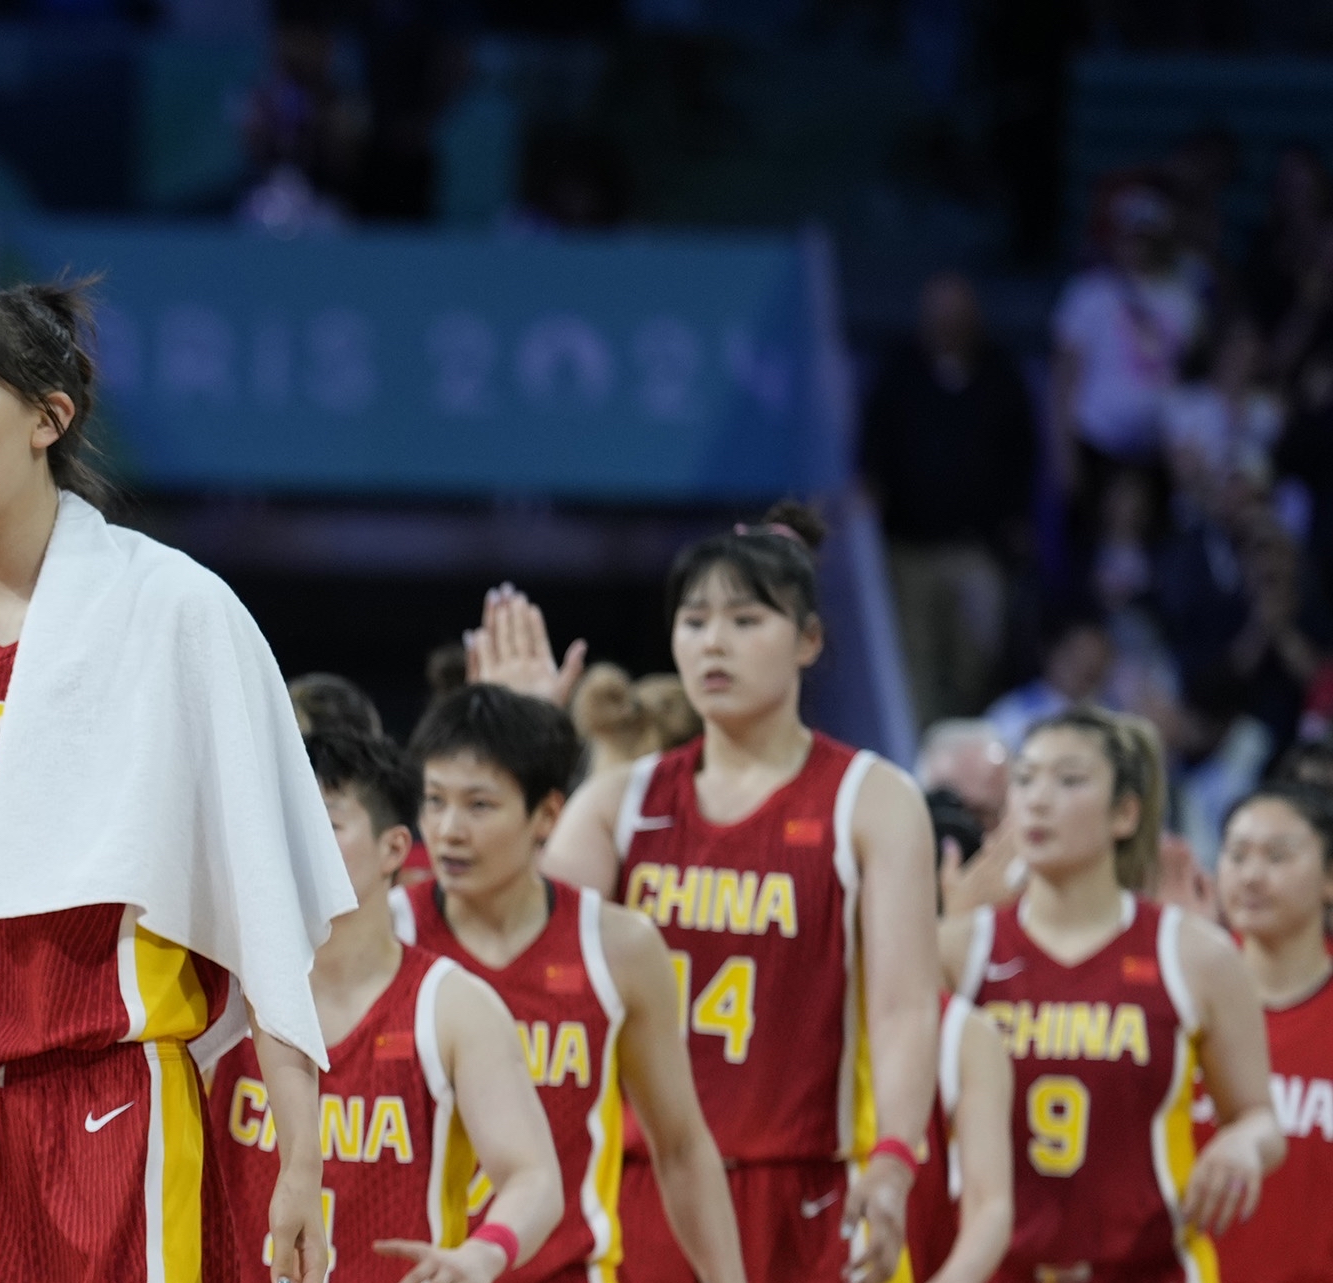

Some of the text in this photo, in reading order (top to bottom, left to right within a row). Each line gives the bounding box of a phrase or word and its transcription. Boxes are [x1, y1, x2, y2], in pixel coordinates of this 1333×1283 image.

[625, 861, 799, 939] CHINA
[228, 1075, 414, 1165] CNA
[1026, 1073, 1091, 1178] 9
